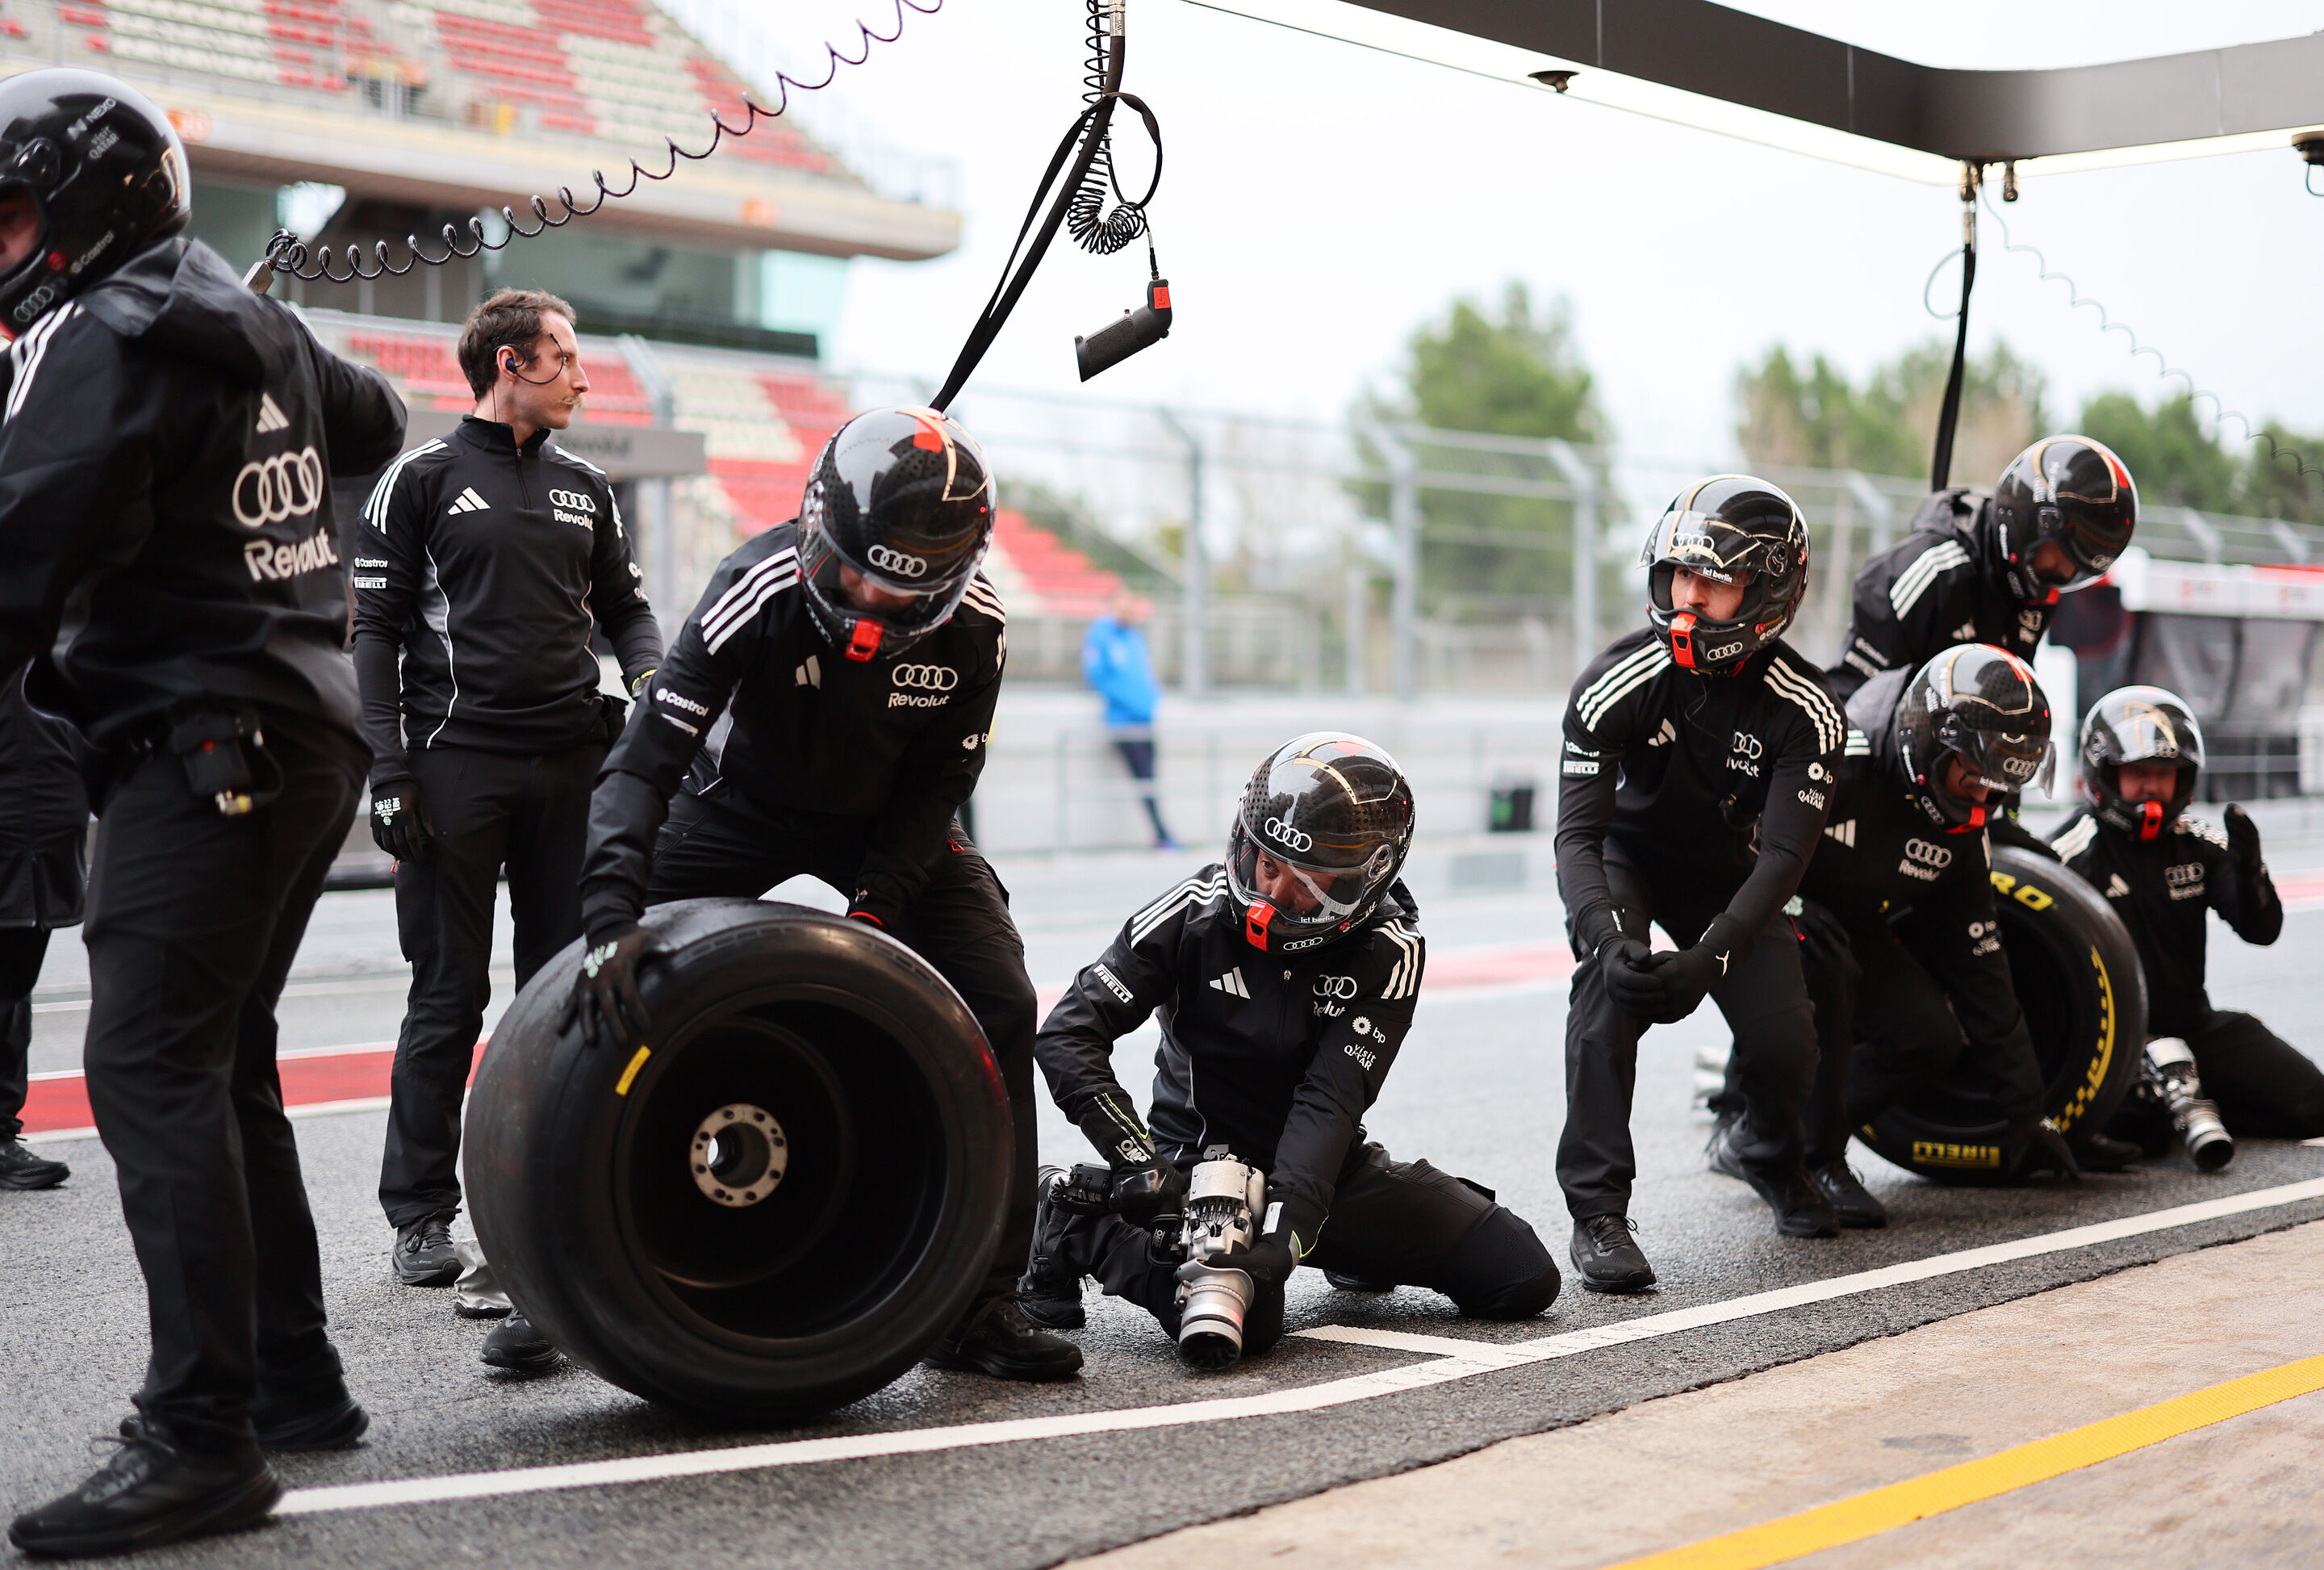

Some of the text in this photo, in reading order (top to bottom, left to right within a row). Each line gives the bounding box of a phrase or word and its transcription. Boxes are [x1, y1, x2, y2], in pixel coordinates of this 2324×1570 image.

[86, 98, 116, 123] NEXO
[89, 133, 119, 159] QATAR
[81, 230, 115, 266] Castrol
[360, 558, 388, 568] Castrol
[353, 576, 387, 589] PIRELLI
[1712, 569, 1733, 583] berlin
[666, 692, 709, 717] Castrol
[888, 692, 951, 708] Revolut
[1798, 789, 1824, 811] QATAR
[1311, 915, 1335, 923] berlin
[1093, 962, 1134, 1003] PIRELLI
[1372, 1026, 1386, 1044] bp
[1344, 1045, 1373, 1071] QATAR
[1355, 1044, 1377, 1064] visit
[1121, 1139, 1147, 1162] OMP
